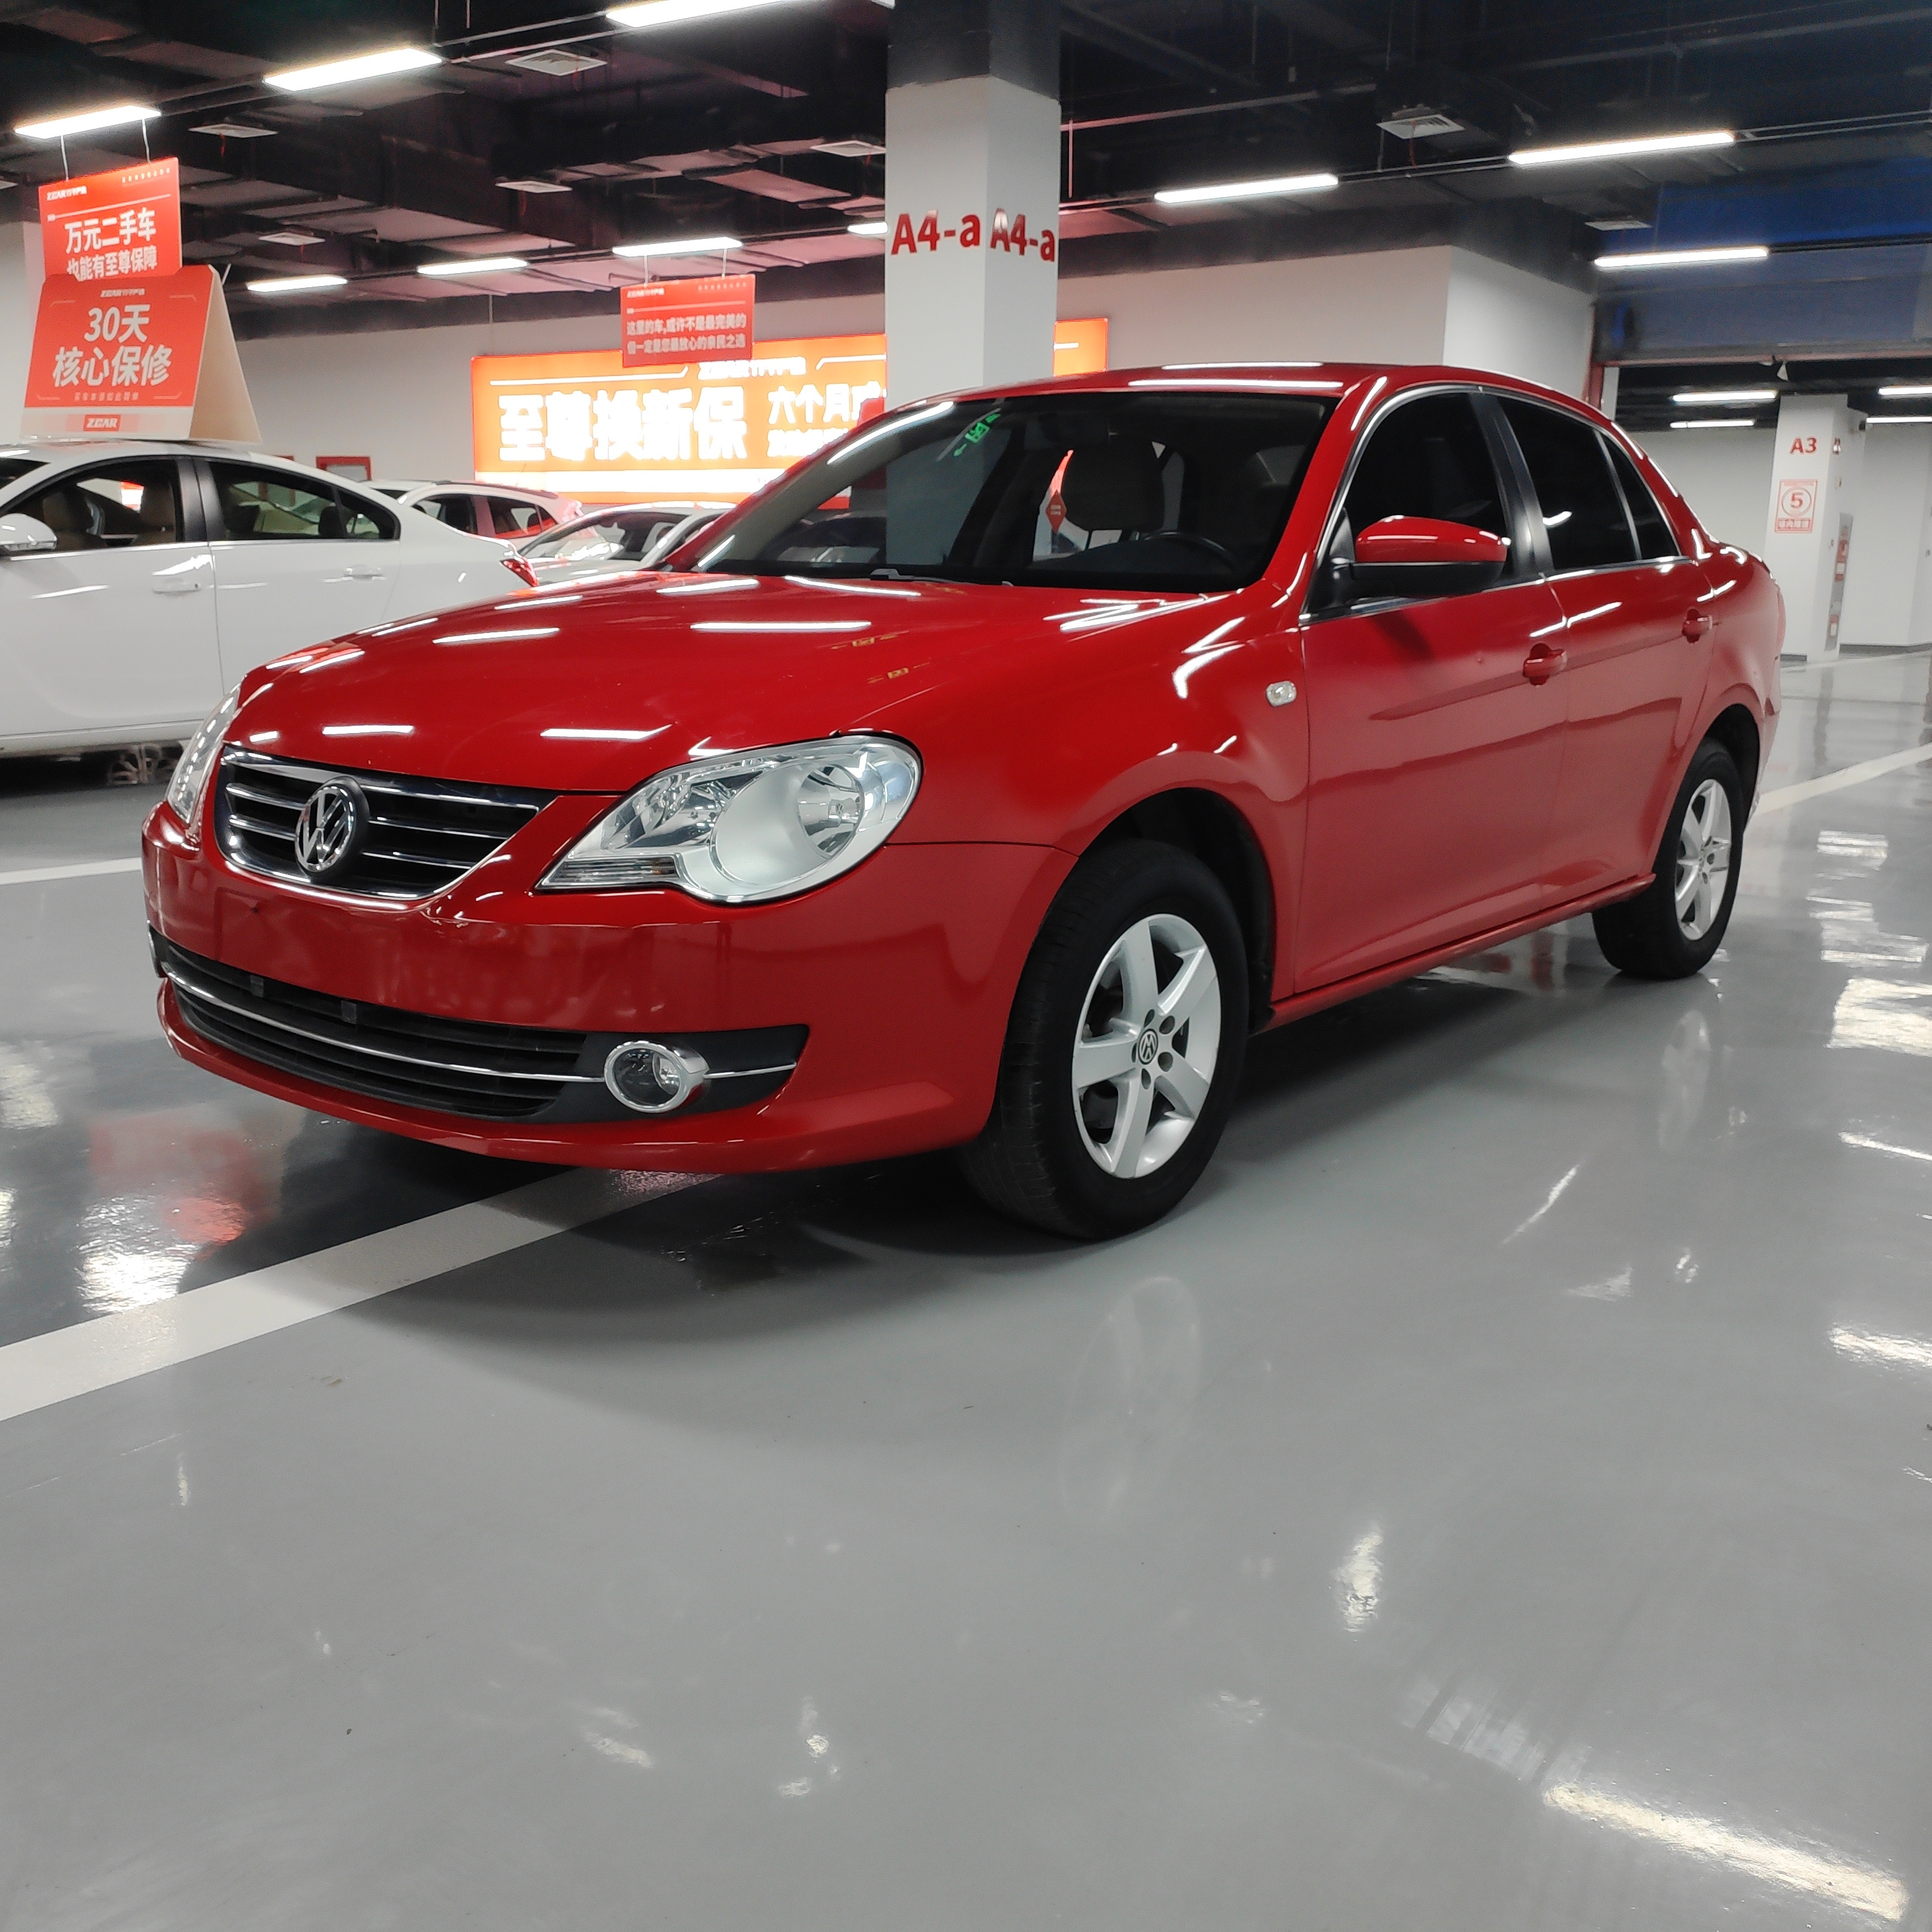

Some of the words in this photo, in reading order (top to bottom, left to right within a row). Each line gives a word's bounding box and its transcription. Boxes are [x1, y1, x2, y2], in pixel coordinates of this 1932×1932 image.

[65, 207, 156, 254] 万元二手车
[891, 210, 981, 255] A4-a
[990, 208, 1055, 262] A4-a
[67, 245, 158, 282] 也能有至尊保障
[84, 304, 151, 343] 30天
[53, 344, 173, 387] 核心保修
[498, 386, 747, 461] 至尊换新保
[1790, 437, 1817, 455] A3
[1790, 492, 1803, 509] 5
